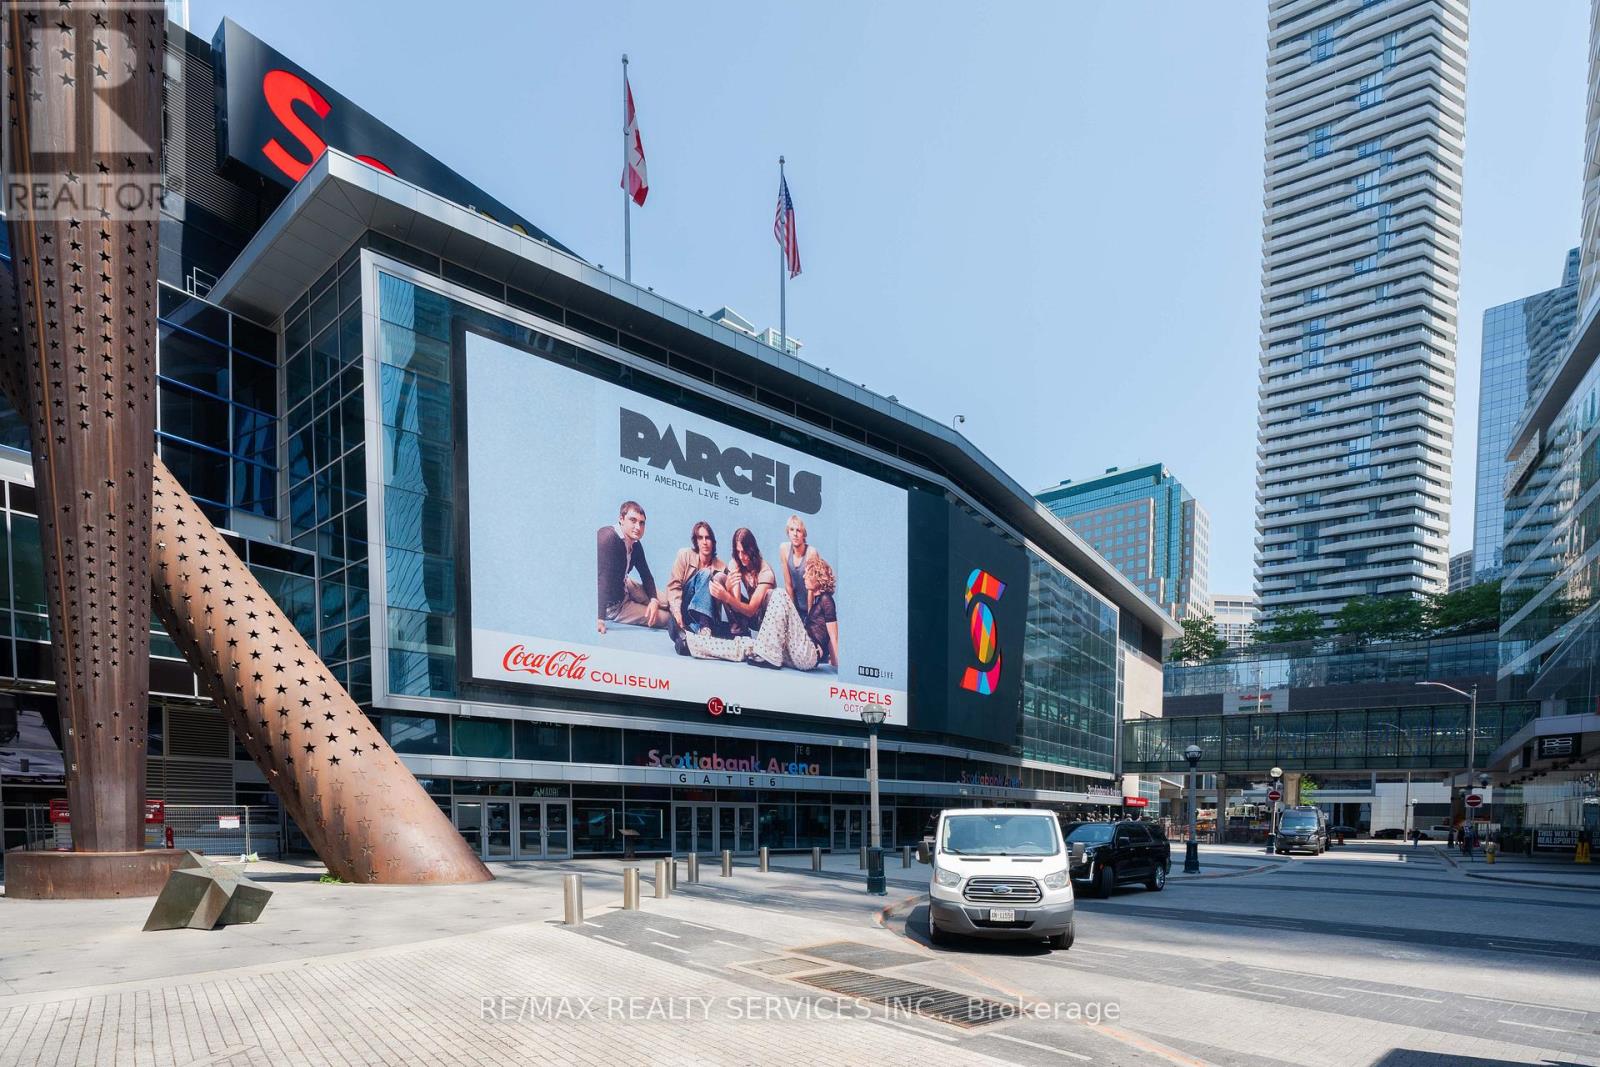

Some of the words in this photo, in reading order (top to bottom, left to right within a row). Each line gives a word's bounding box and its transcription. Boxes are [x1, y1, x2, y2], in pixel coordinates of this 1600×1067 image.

[620, 407, 822, 515] PARCELS
[620, 463, 649, 479] NORTH
[655, 474, 693, 493] AMERICA
[698, 487, 719, 501] LIVE
[725, 495, 740, 506] '25
[503, 644, 591, 680] Coca-Cola
[590, 670, 670, 690] COLISEUM
[726, 703, 742, 715] LG
[830, 687, 892, 705] PARCELS
[648, 749, 761, 772] Scotiabank
[767, 757, 820, 776] Arena
